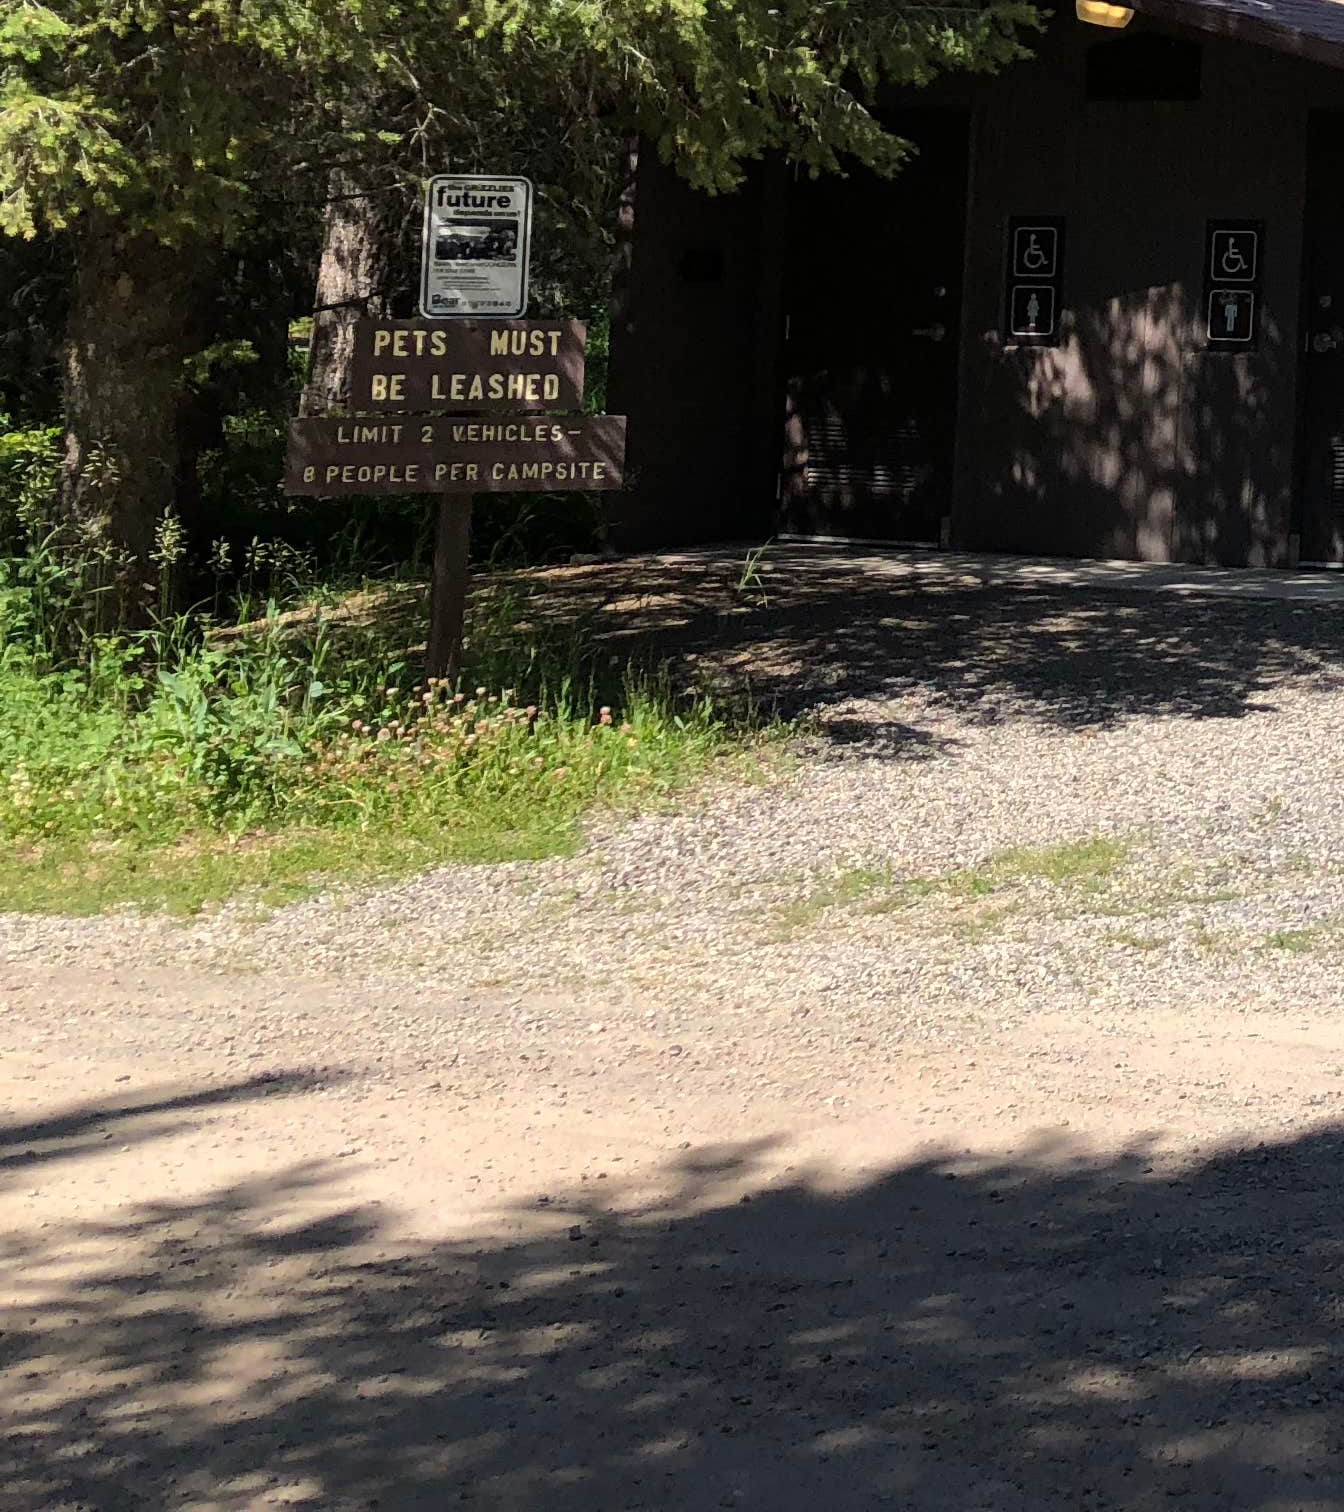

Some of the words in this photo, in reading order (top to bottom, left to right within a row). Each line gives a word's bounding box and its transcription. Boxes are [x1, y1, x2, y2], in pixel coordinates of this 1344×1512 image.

[437, 186, 511, 208] future
[374, 330, 447, 356] PETS
[491, 330, 561, 356] MUST
[372, 374, 405, 400] BE
[431, 374, 559, 400] LEASHED
[338, 426, 403, 443] LIMIT
[421, 426, 433, 443] 2
[303, 466, 315, 483] 8
[326, 465, 419, 482] PEOPLE
[435, 463, 478, 481] PER
[492, 462, 606, 480] CAMPSITE
